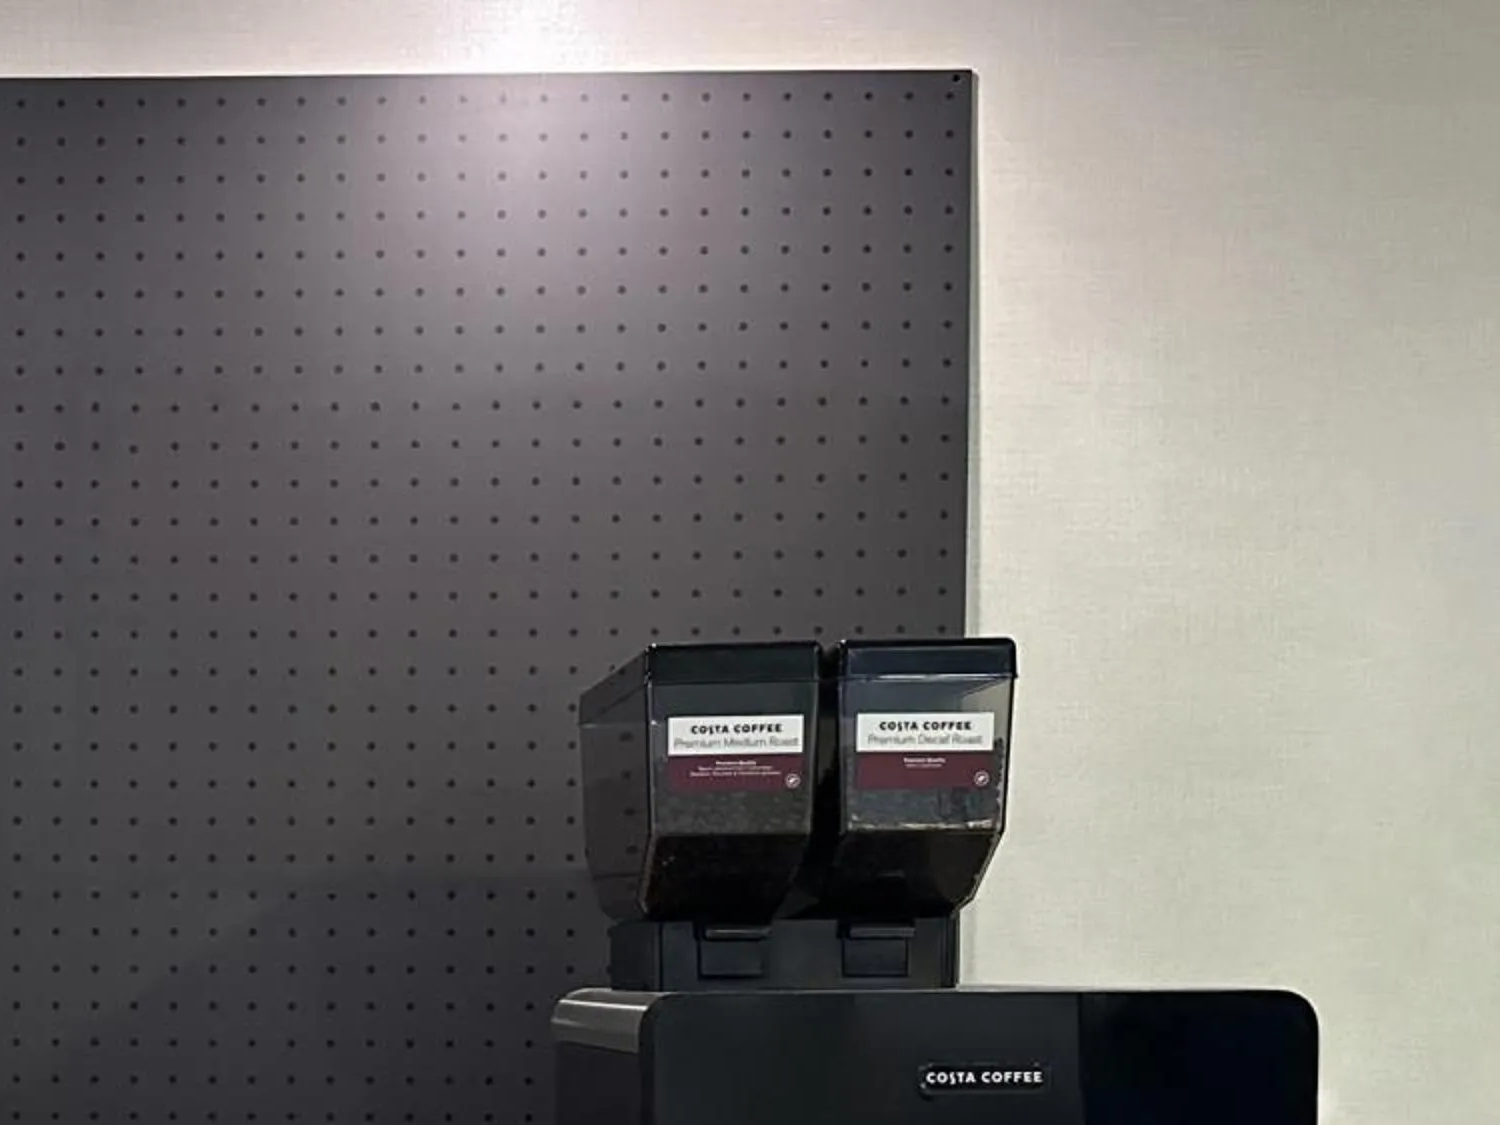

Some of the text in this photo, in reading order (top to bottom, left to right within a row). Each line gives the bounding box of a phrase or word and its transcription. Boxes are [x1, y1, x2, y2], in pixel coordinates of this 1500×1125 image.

[691, 723, 783, 735] COSTA COFFEE
[879, 721, 972, 732] COSTA COFFEE
[926, 1071, 1043, 1085] COSTA COFFEE
